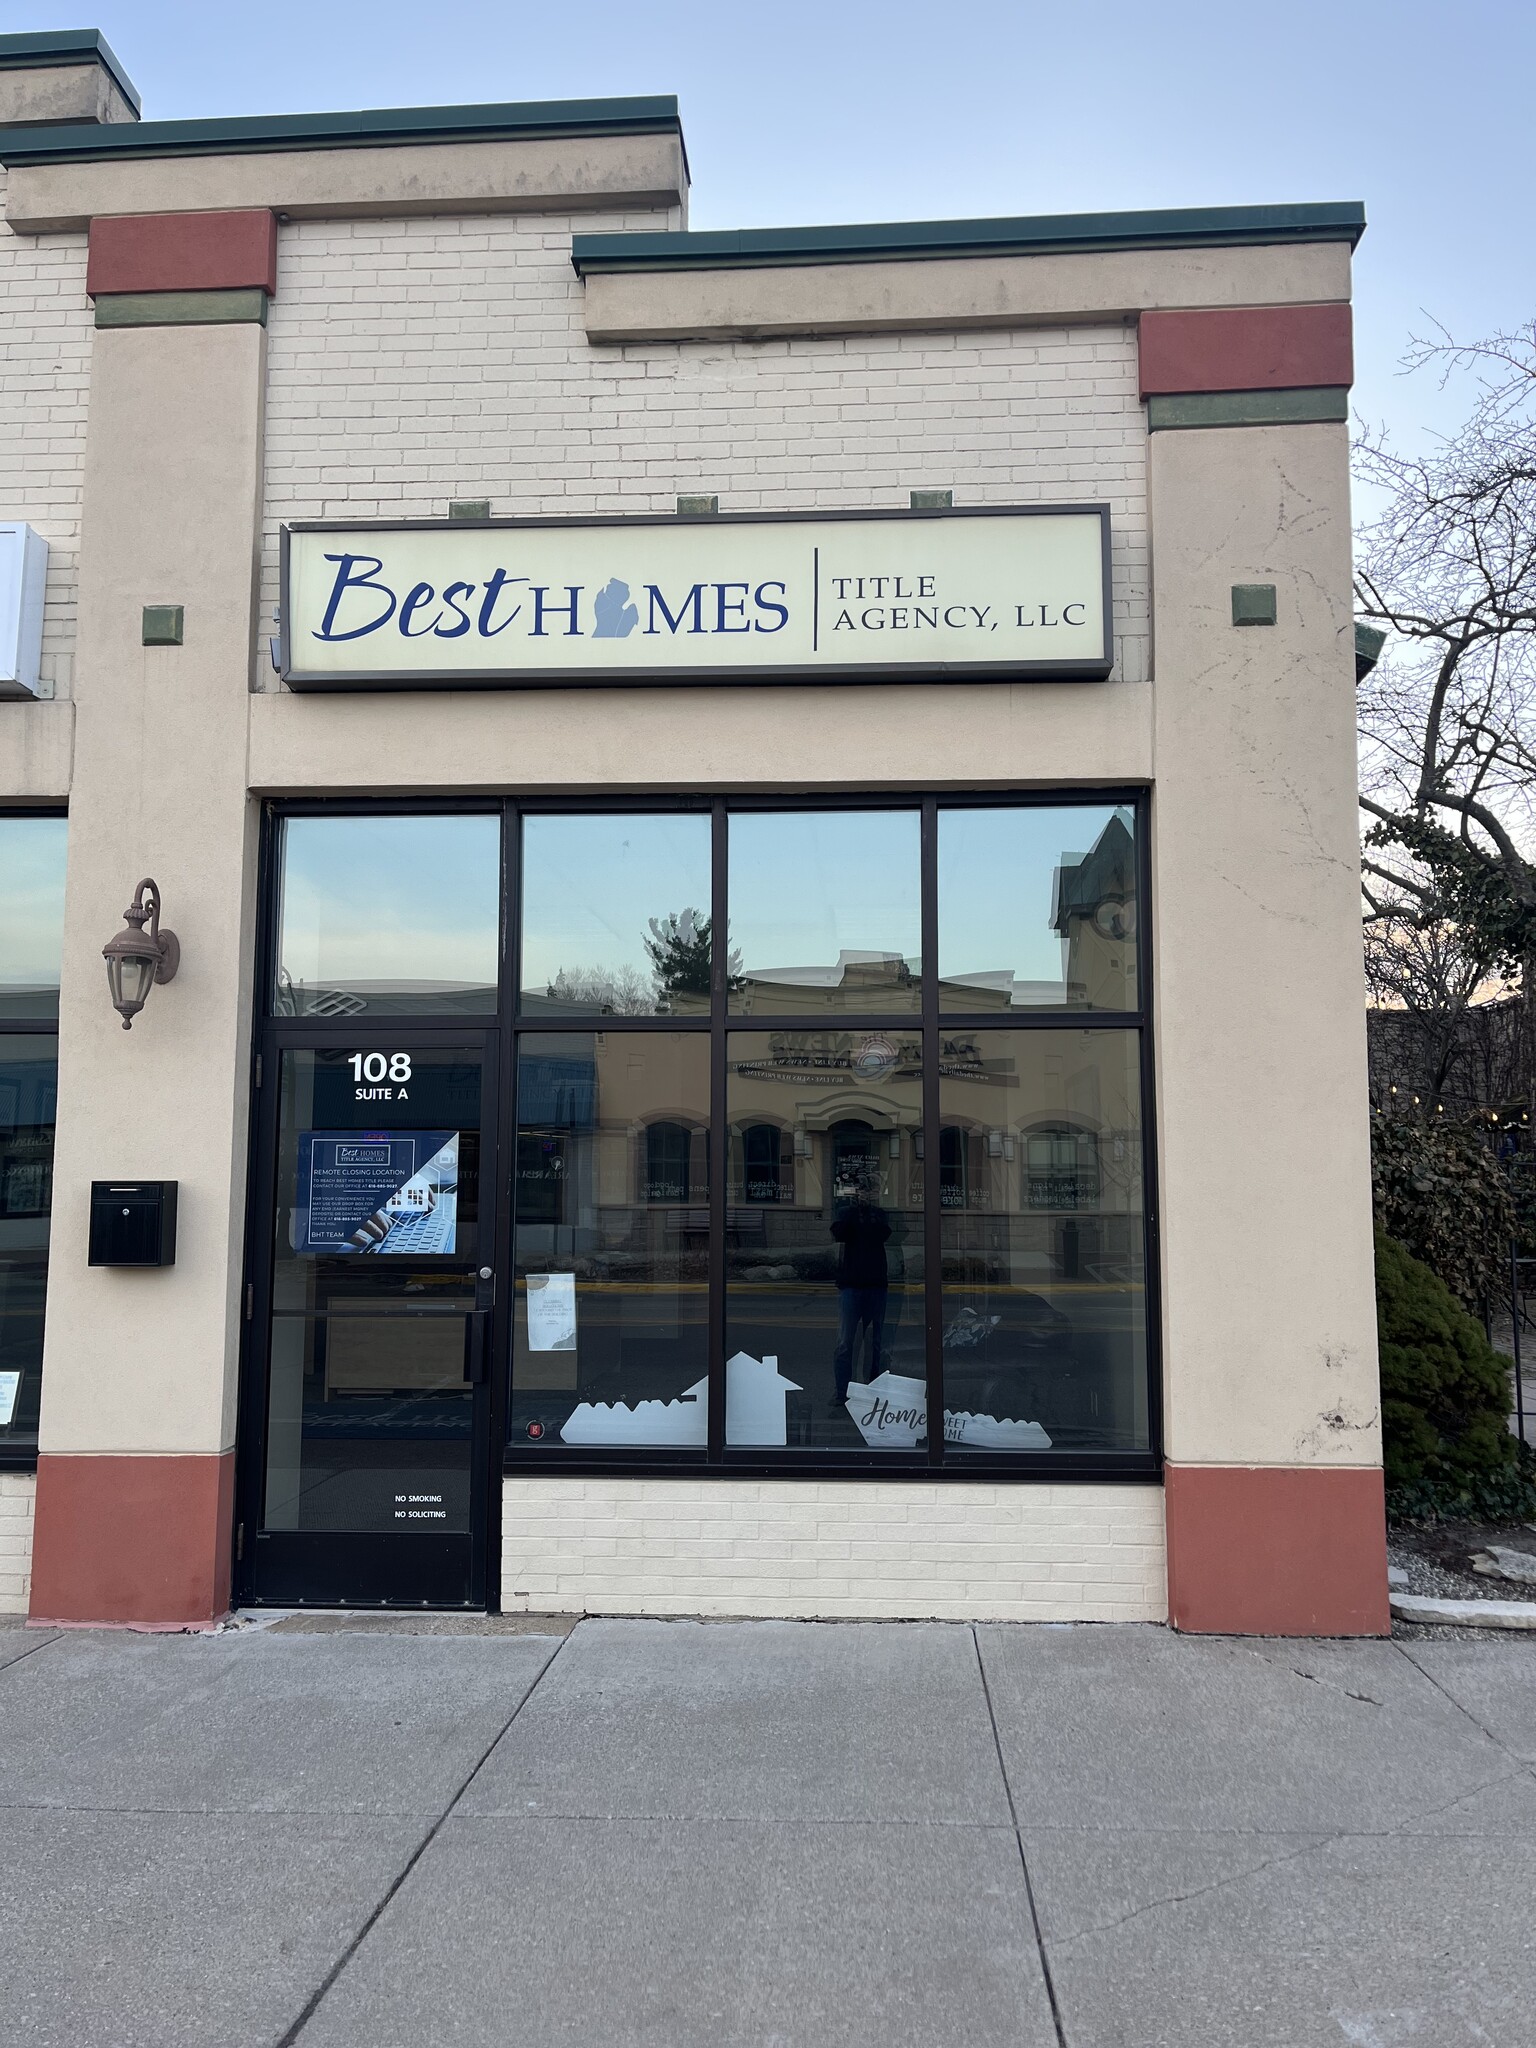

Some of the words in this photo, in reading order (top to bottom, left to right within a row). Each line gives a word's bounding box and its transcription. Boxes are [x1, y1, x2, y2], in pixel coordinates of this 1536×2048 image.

[311, 553, 530, 641] Best
[529, 577, 790, 638] HMES
[832, 575, 938, 601] TITLE
[832, 604, 999, 633] AGENCY,
[1015, 602, 1087, 627] LLC
[347, 1053, 412, 1082] 108
[355, 1088, 392, 1100] SUITE
[397, 1088, 409, 1099] A
[341, 1147, 359, 1157] Best
[861, 1397, 928, 1430] Home
